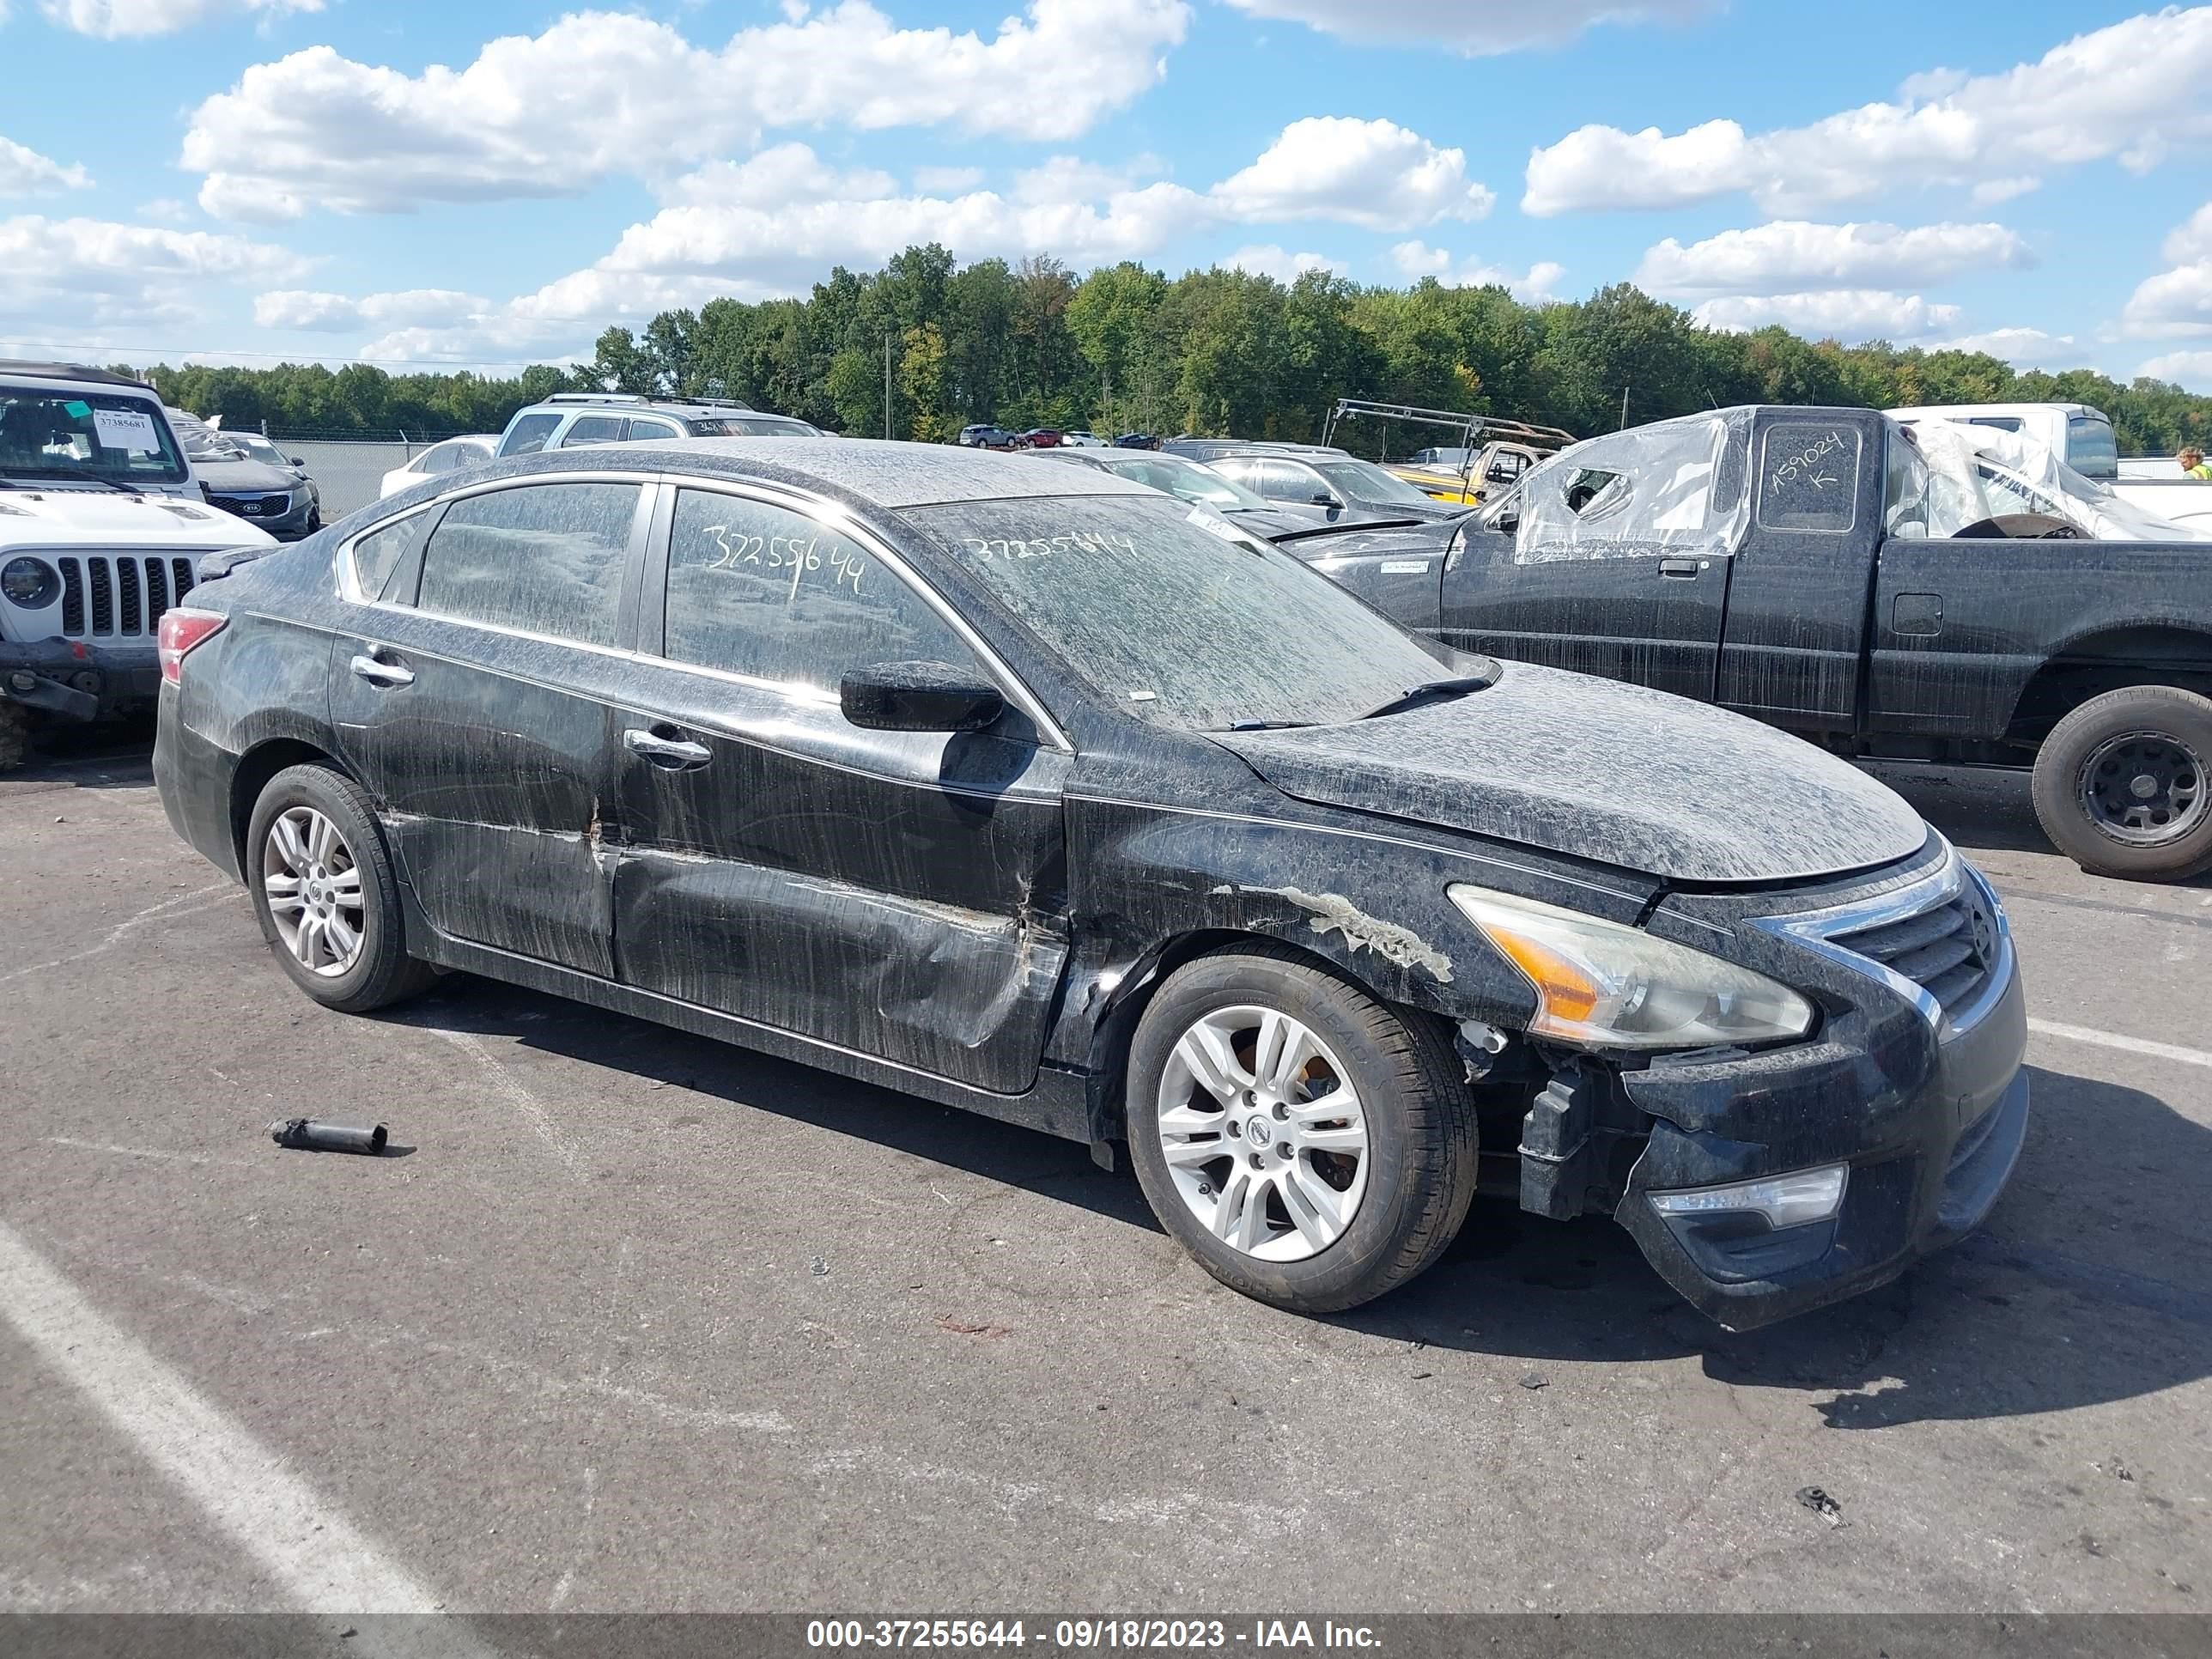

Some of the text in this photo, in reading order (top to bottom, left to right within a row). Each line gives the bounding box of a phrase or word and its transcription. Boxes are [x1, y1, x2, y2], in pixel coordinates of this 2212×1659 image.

[100, 417, 145, 428] 37385681
[1808, 470, 1838, 489] K
[963, 532, 1137, 561] 37255644
[703, 526, 874, 599] 37255644
